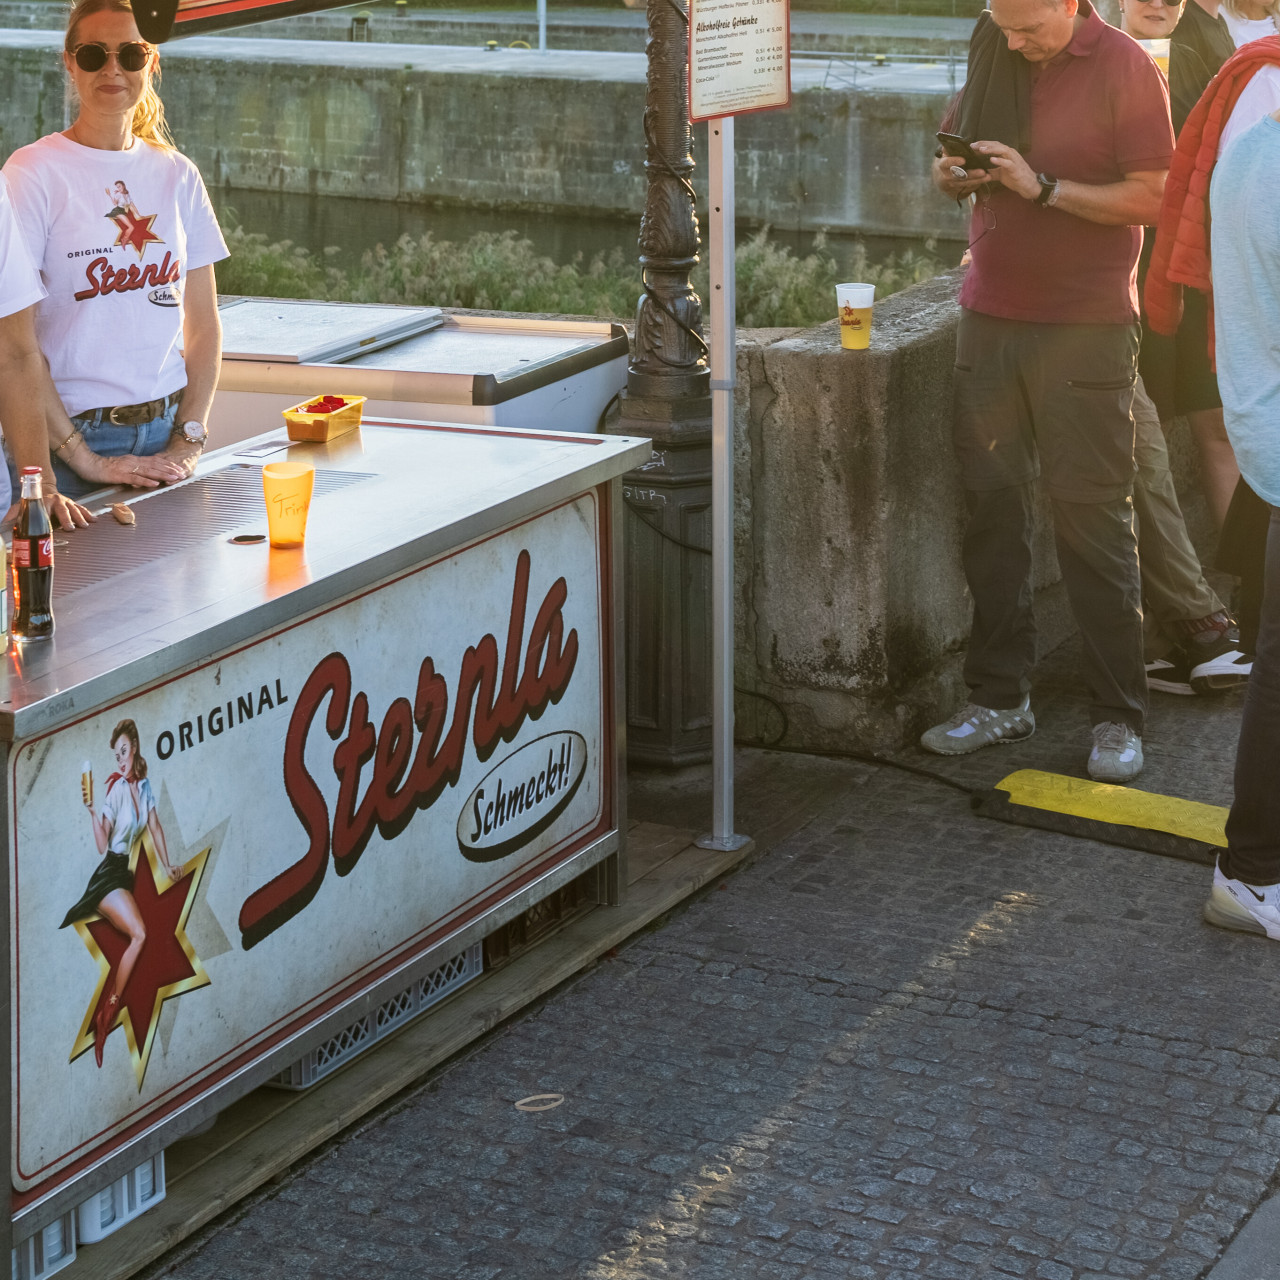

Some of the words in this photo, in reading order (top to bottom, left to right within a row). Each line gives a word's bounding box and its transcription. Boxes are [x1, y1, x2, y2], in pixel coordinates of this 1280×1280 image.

[696, 18, 731, 34] Alkoholfreie
[732, 15, 758, 29] Getränke
[67, 247, 114, 259] ORIGINAL
[155, 679, 289, 761] ORIGINAL
[238, 549, 580, 951] Sternla
[471, 735, 573, 843] Schmeckt!
